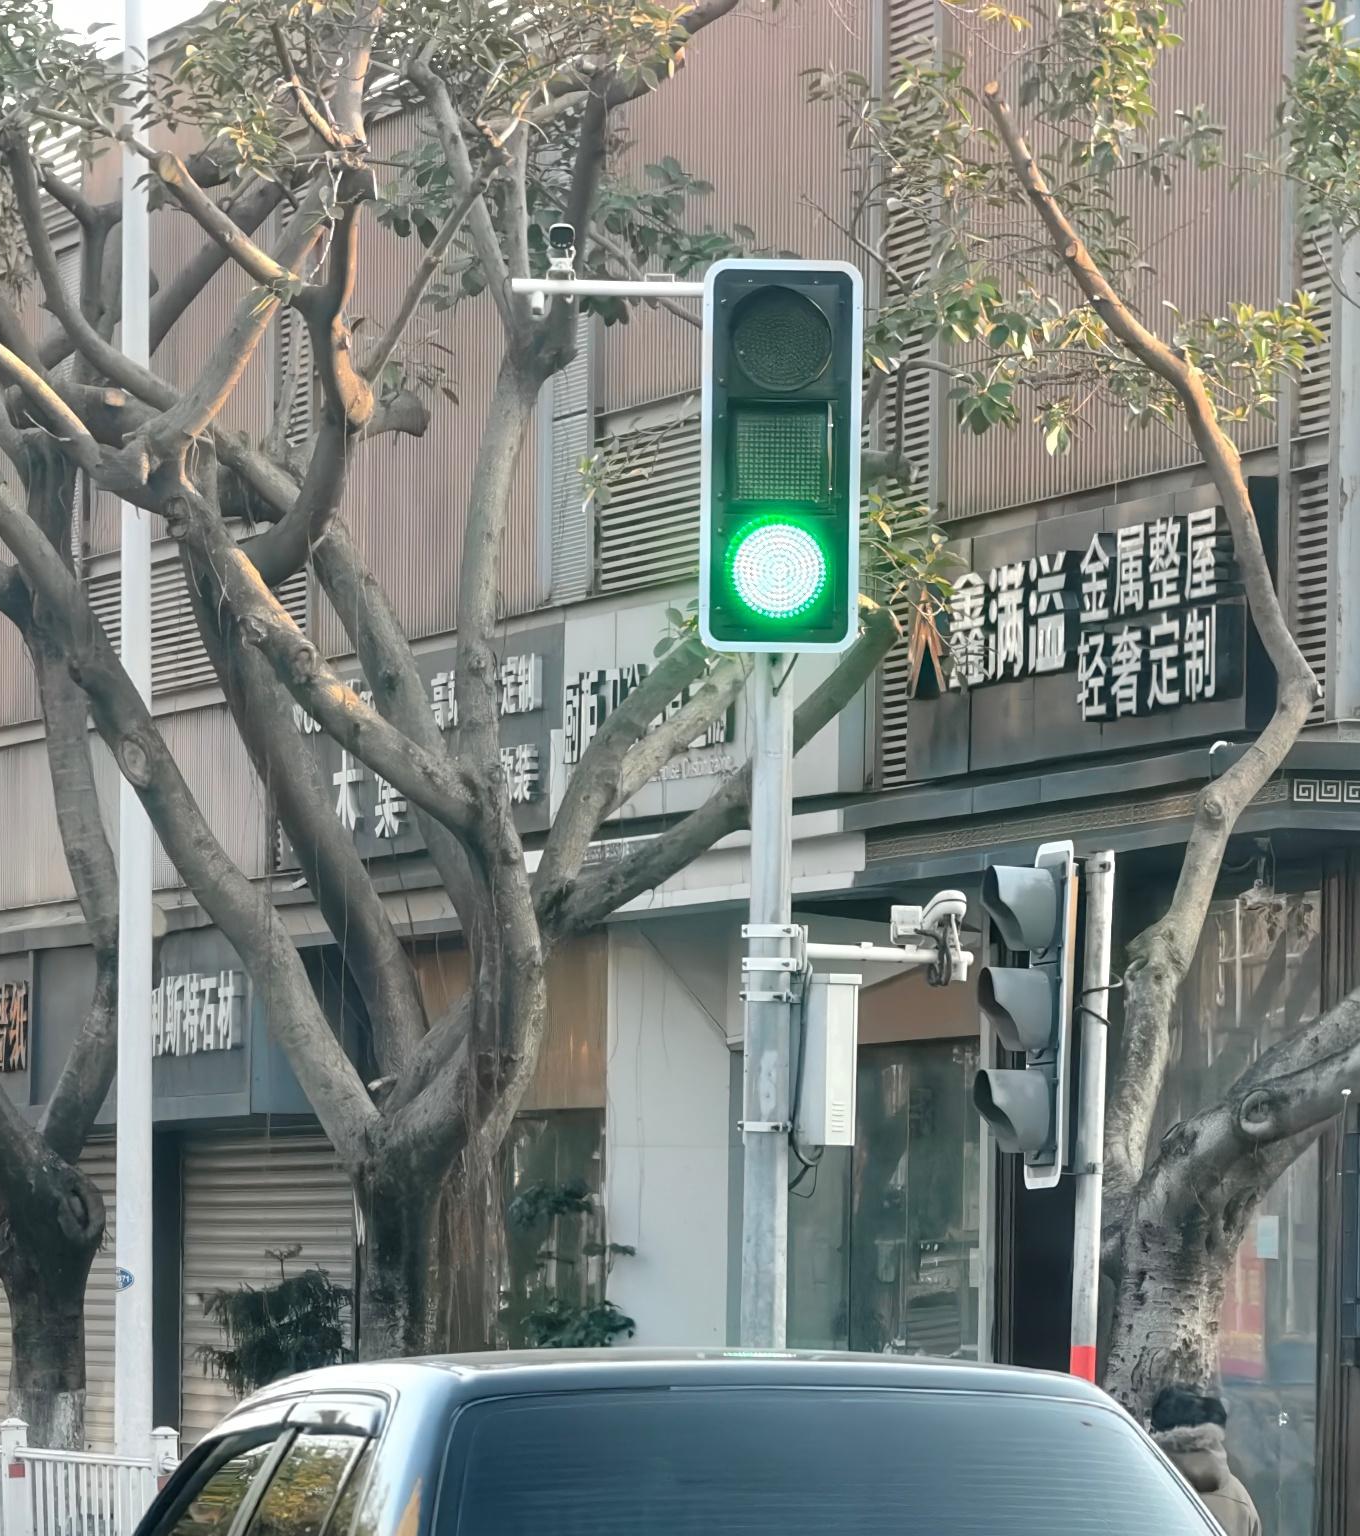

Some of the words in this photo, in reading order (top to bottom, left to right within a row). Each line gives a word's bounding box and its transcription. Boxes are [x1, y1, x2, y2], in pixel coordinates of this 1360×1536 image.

[1078, 506, 1217, 623] 金属整屋
[1076, 604, 1217, 722] 轻奢定制
